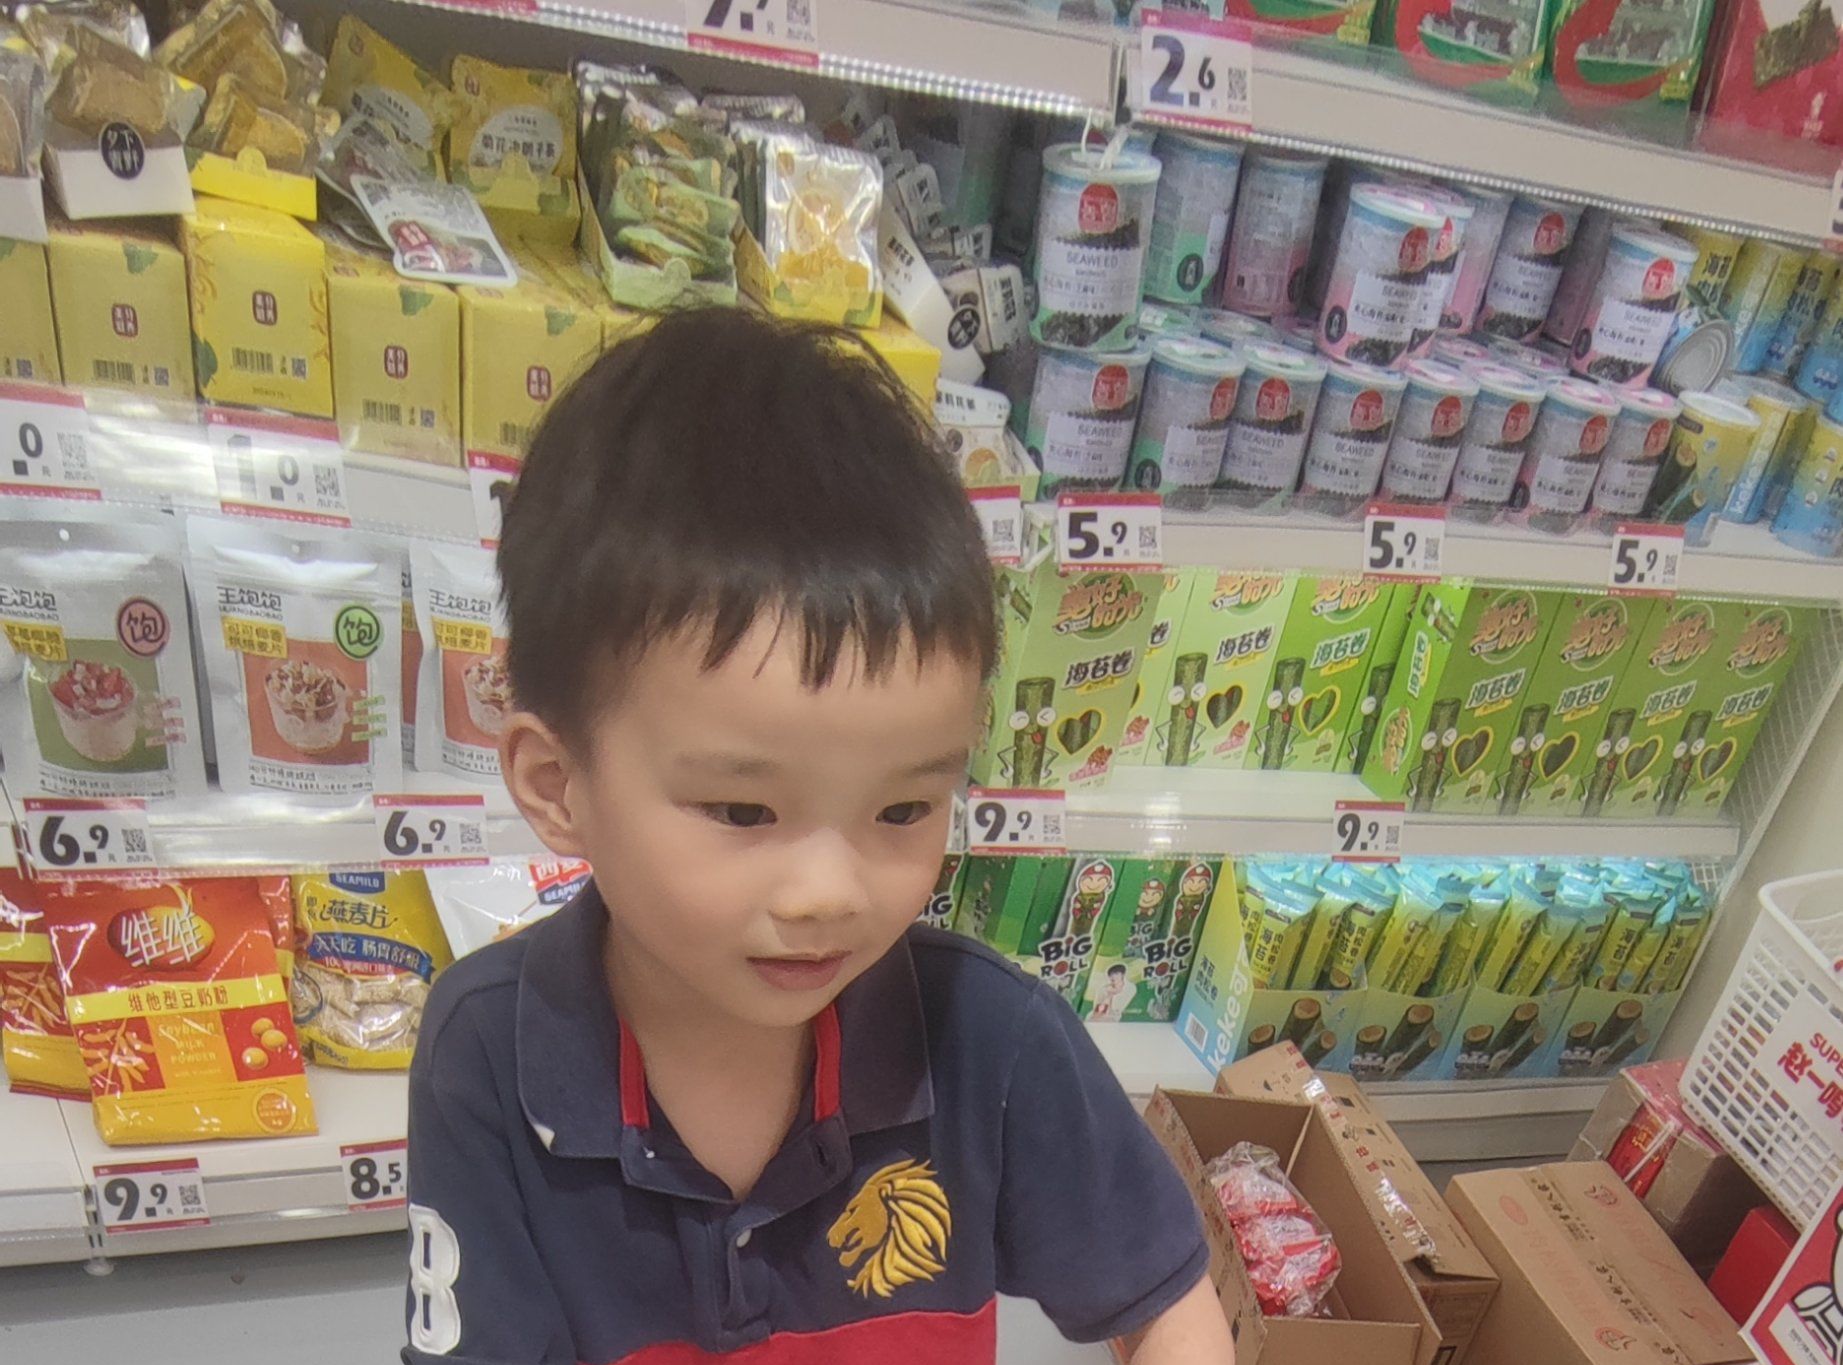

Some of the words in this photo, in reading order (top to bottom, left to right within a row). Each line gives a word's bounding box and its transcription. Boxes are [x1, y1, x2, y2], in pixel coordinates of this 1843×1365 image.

[1150, 35, 1215, 106] 2.6
[1066, 251, 1118, 267] SEAWEED
[1067, 512, 1128, 558] 5.9
[1369, 521, 1417, 568] 5.9
[1614, 539, 1658, 584] 5.9
[218, 586, 281, 611] 王饱饱
[1216, 626, 1273, 661] 海苔卷
[1311, 630, 1370, 668] 海苔卷
[1065, 650, 1133, 686] 海苔卷
[39, 816, 109, 866] 6.9
[384, 811, 446, 856] 6.9
[975, 802, 1033, 841] 9.9
[1337, 813, 1379, 851] 9.9
[326, 899, 390, 929] 燕麦片
[120, 909, 207, 967] 维维
[128, 985, 229, 1012] 维他型豆奶粉
[104, 1175, 168, 1221] 9.9
[350, 1157, 401, 1199] 8.5
